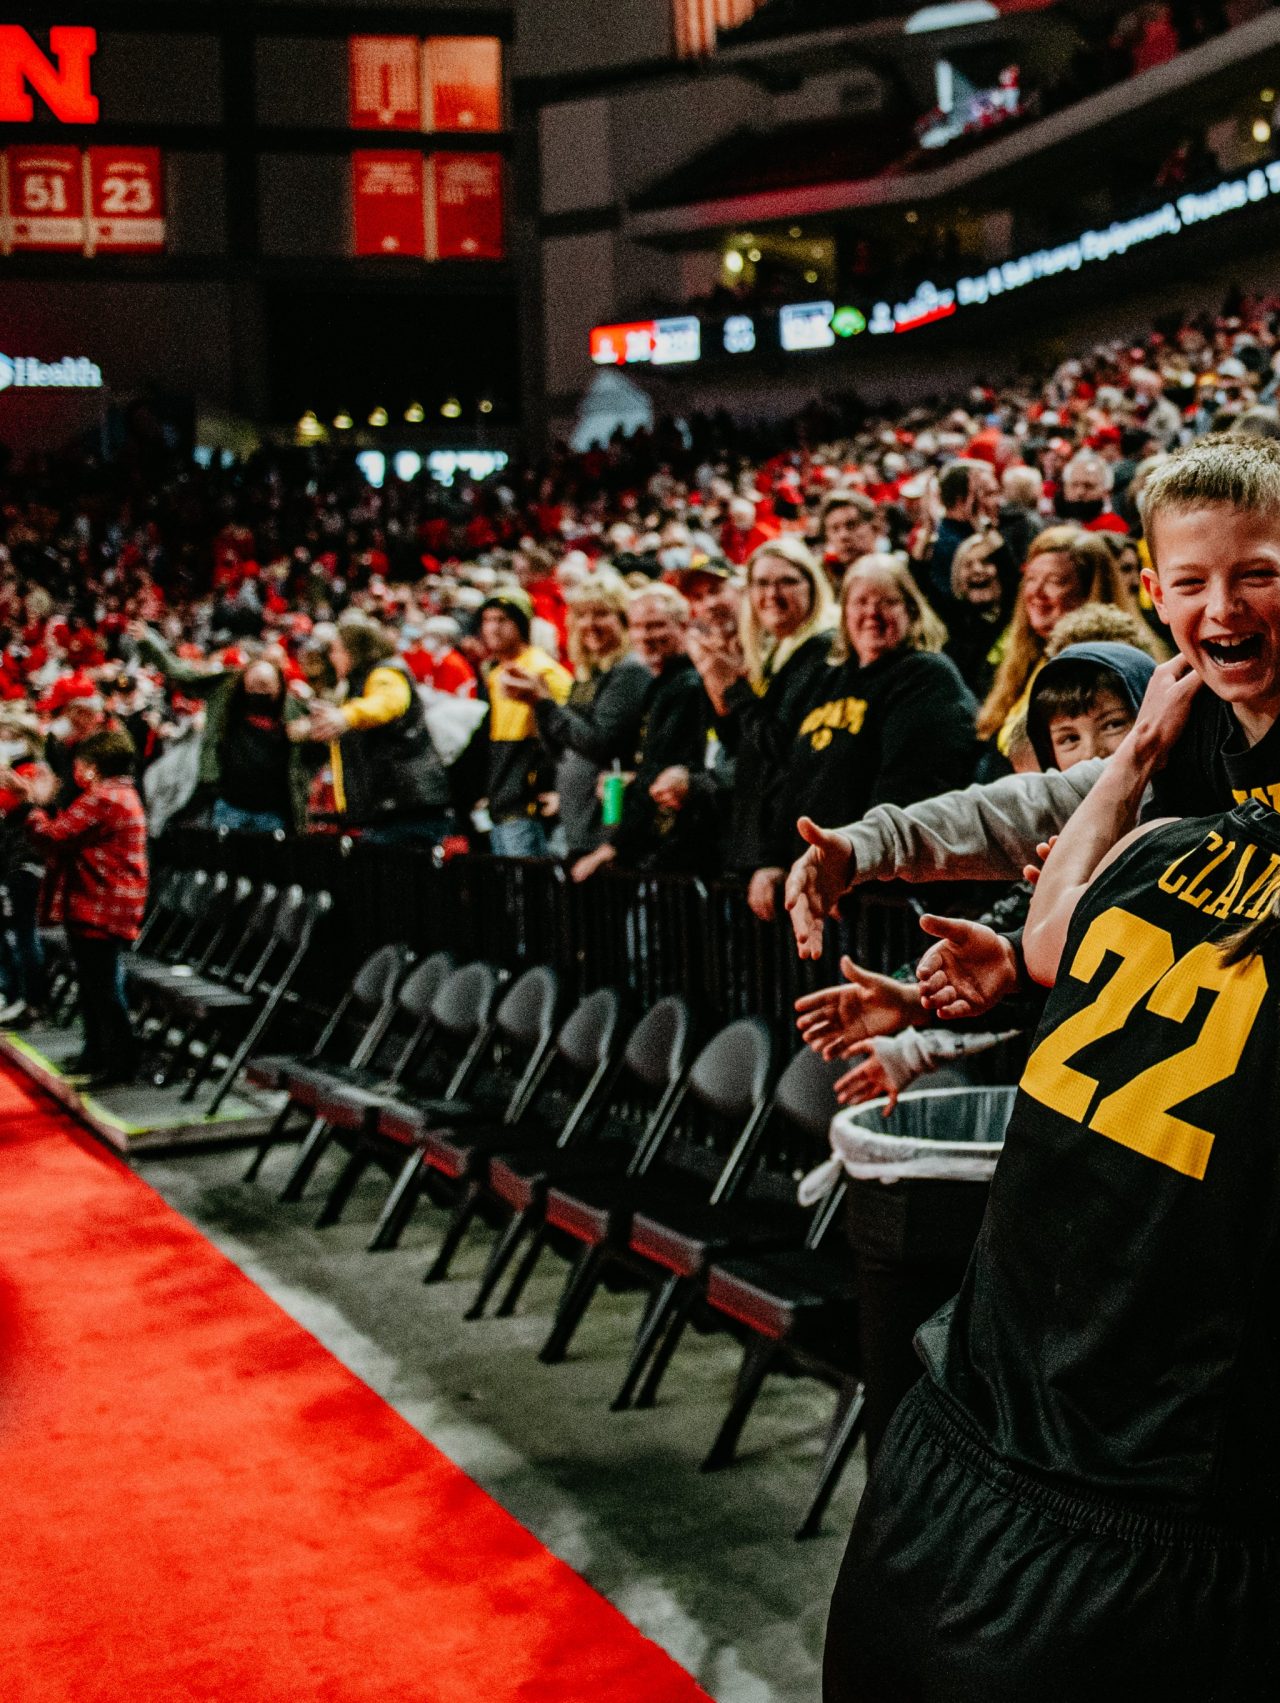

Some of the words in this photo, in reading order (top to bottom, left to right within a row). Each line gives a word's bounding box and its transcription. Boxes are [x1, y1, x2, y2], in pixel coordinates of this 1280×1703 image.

[0, 24, 99, 124] N
[24, 174, 67, 212] 51
[102, 177, 152, 213] 23
[13, 356, 102, 387] Health
[1019, 906, 1269, 1181] 22
